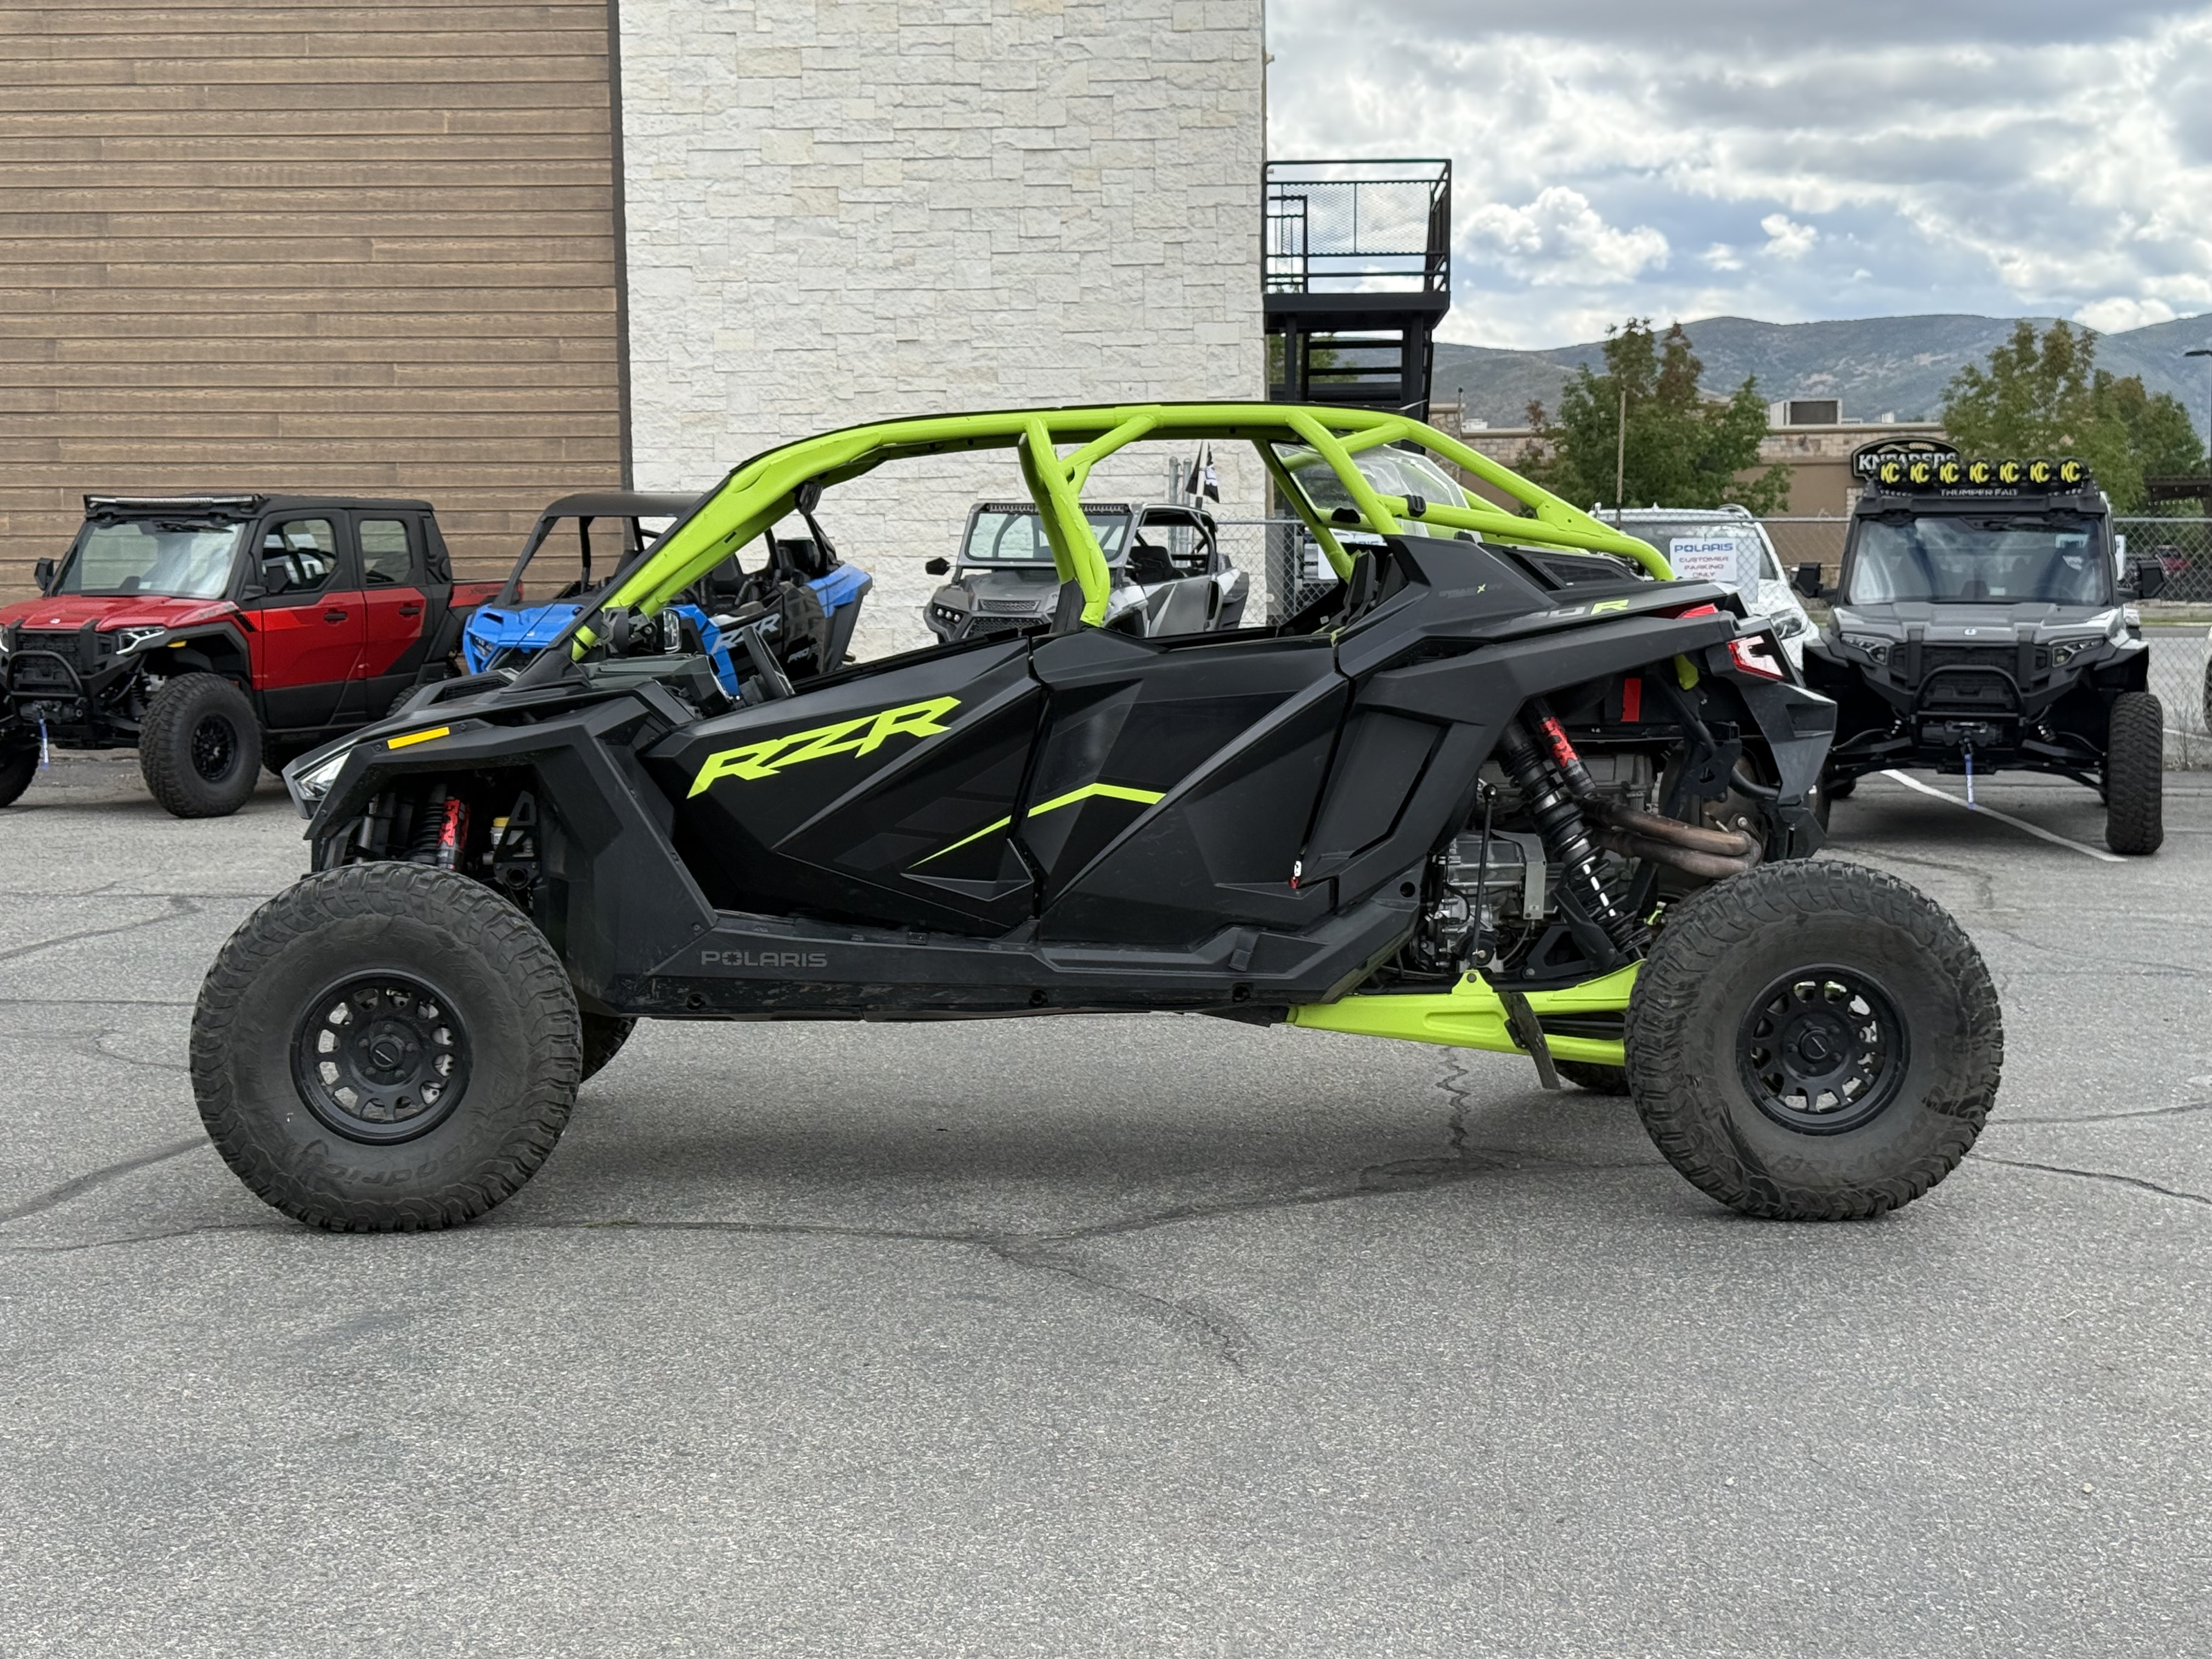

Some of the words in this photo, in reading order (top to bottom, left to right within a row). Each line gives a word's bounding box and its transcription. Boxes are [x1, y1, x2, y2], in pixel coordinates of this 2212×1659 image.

[1880, 461, 1900, 484] KC
[1910, 461, 1929, 484] KC
[1939, 461, 1960, 484] KC
[1969, 461, 1990, 484] KC
[1999, 461, 2020, 483] KC
[2030, 461, 2051, 483] KC
[2061, 461, 2082, 483] KC
[1674, 543, 1733, 553] POLARIS
[1590, 599, 1629, 615] R
[686, 696, 962, 799] RZR
[701, 950, 827, 968] POLARIS
